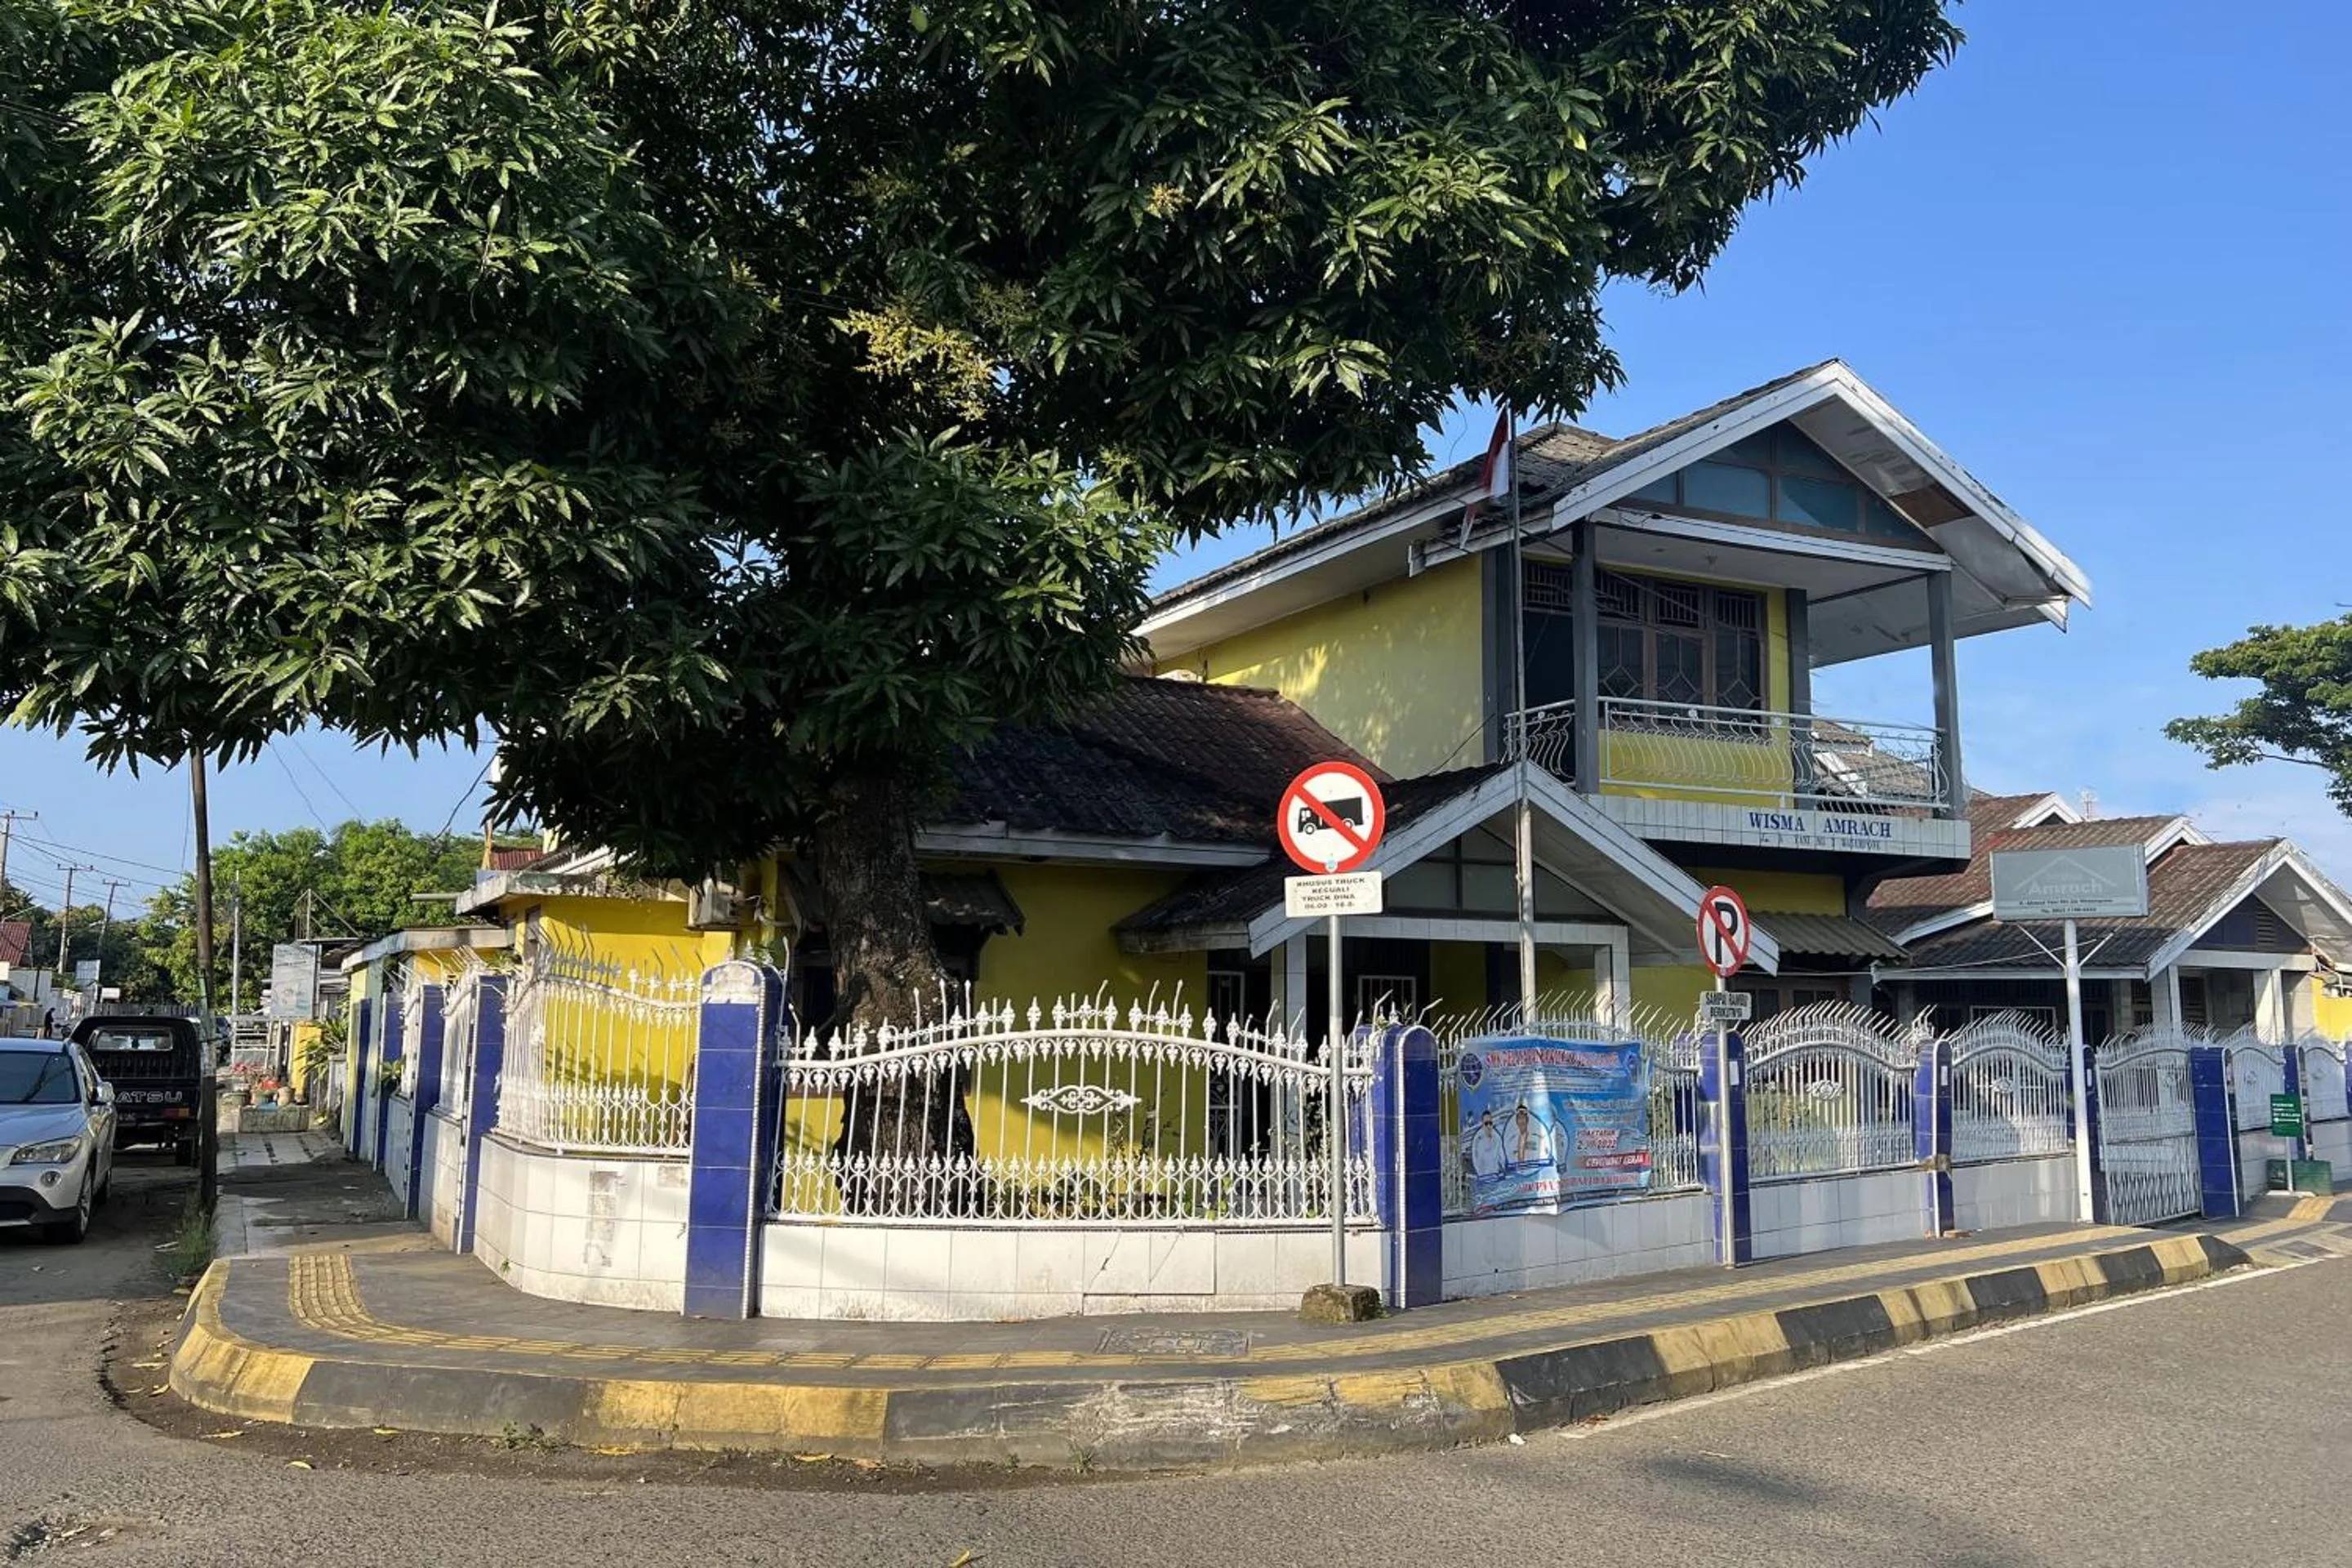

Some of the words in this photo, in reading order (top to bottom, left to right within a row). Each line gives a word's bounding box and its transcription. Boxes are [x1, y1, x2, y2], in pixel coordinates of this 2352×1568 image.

[1749, 812, 1805, 831] WISMA
[1823, 817, 1892, 838] AMRACH
[115, 1090, 183, 1103] ATSU
